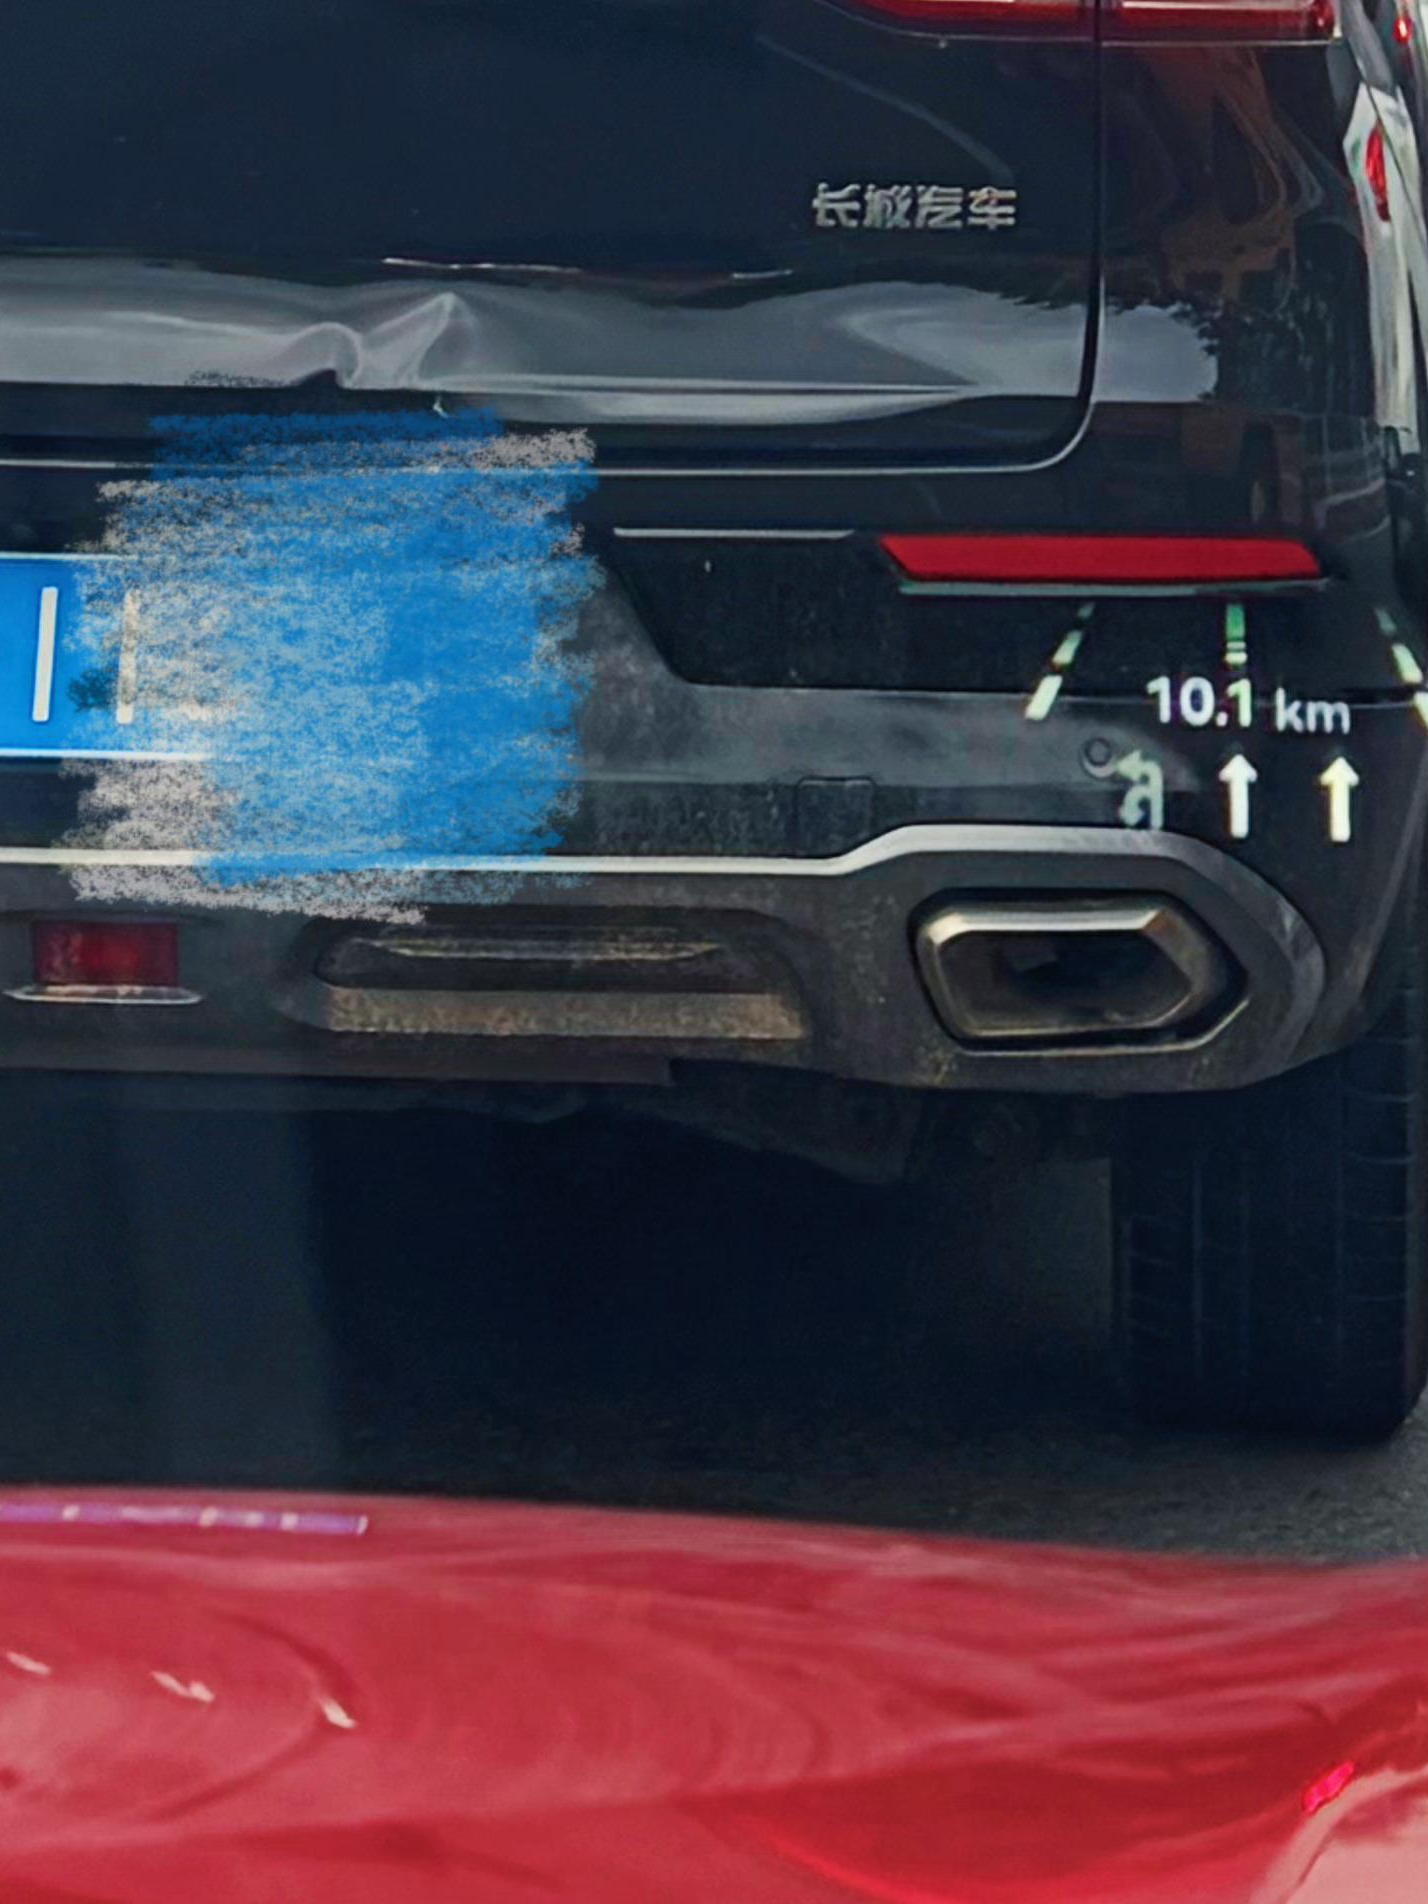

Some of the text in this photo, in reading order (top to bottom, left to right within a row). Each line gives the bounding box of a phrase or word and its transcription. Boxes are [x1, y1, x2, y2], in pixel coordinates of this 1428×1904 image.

[811, 182, 1018, 230] 长城汽车
[1145, 675, 1351, 735] 10.1 km
